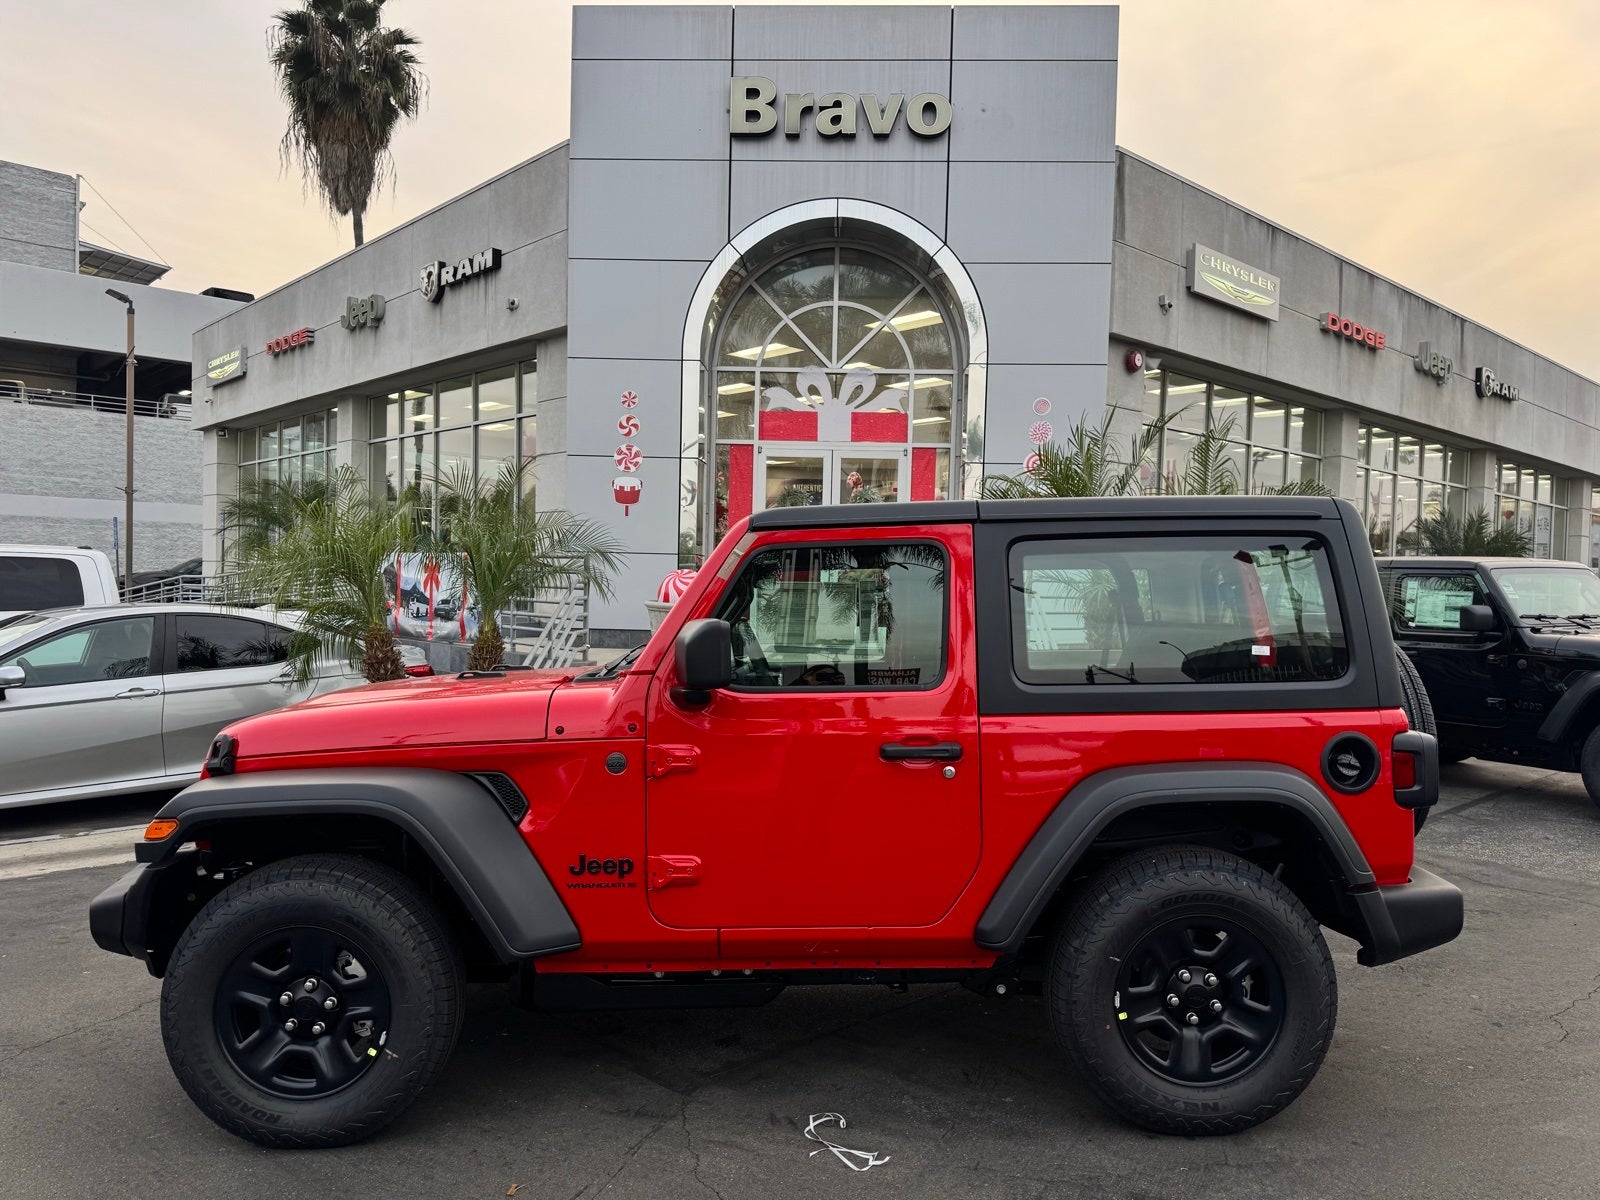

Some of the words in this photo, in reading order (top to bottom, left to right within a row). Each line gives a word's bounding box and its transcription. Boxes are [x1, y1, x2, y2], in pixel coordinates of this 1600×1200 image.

[729, 76, 953, 137] Bravo
[440, 247, 495, 286] RAM
[1200, 253, 1276, 293] CHRYSLER
[340, 294, 383, 330] Jeep
[265, 327, 310, 356] DODGE
[1327, 312, 1386, 350] DODGE
[207, 350, 240, 369] CHRYSLER
[1414, 341, 1454, 387] Jeep
[1493, 378, 1520, 401] RAM
[568, 854, 634, 879] Jeep
